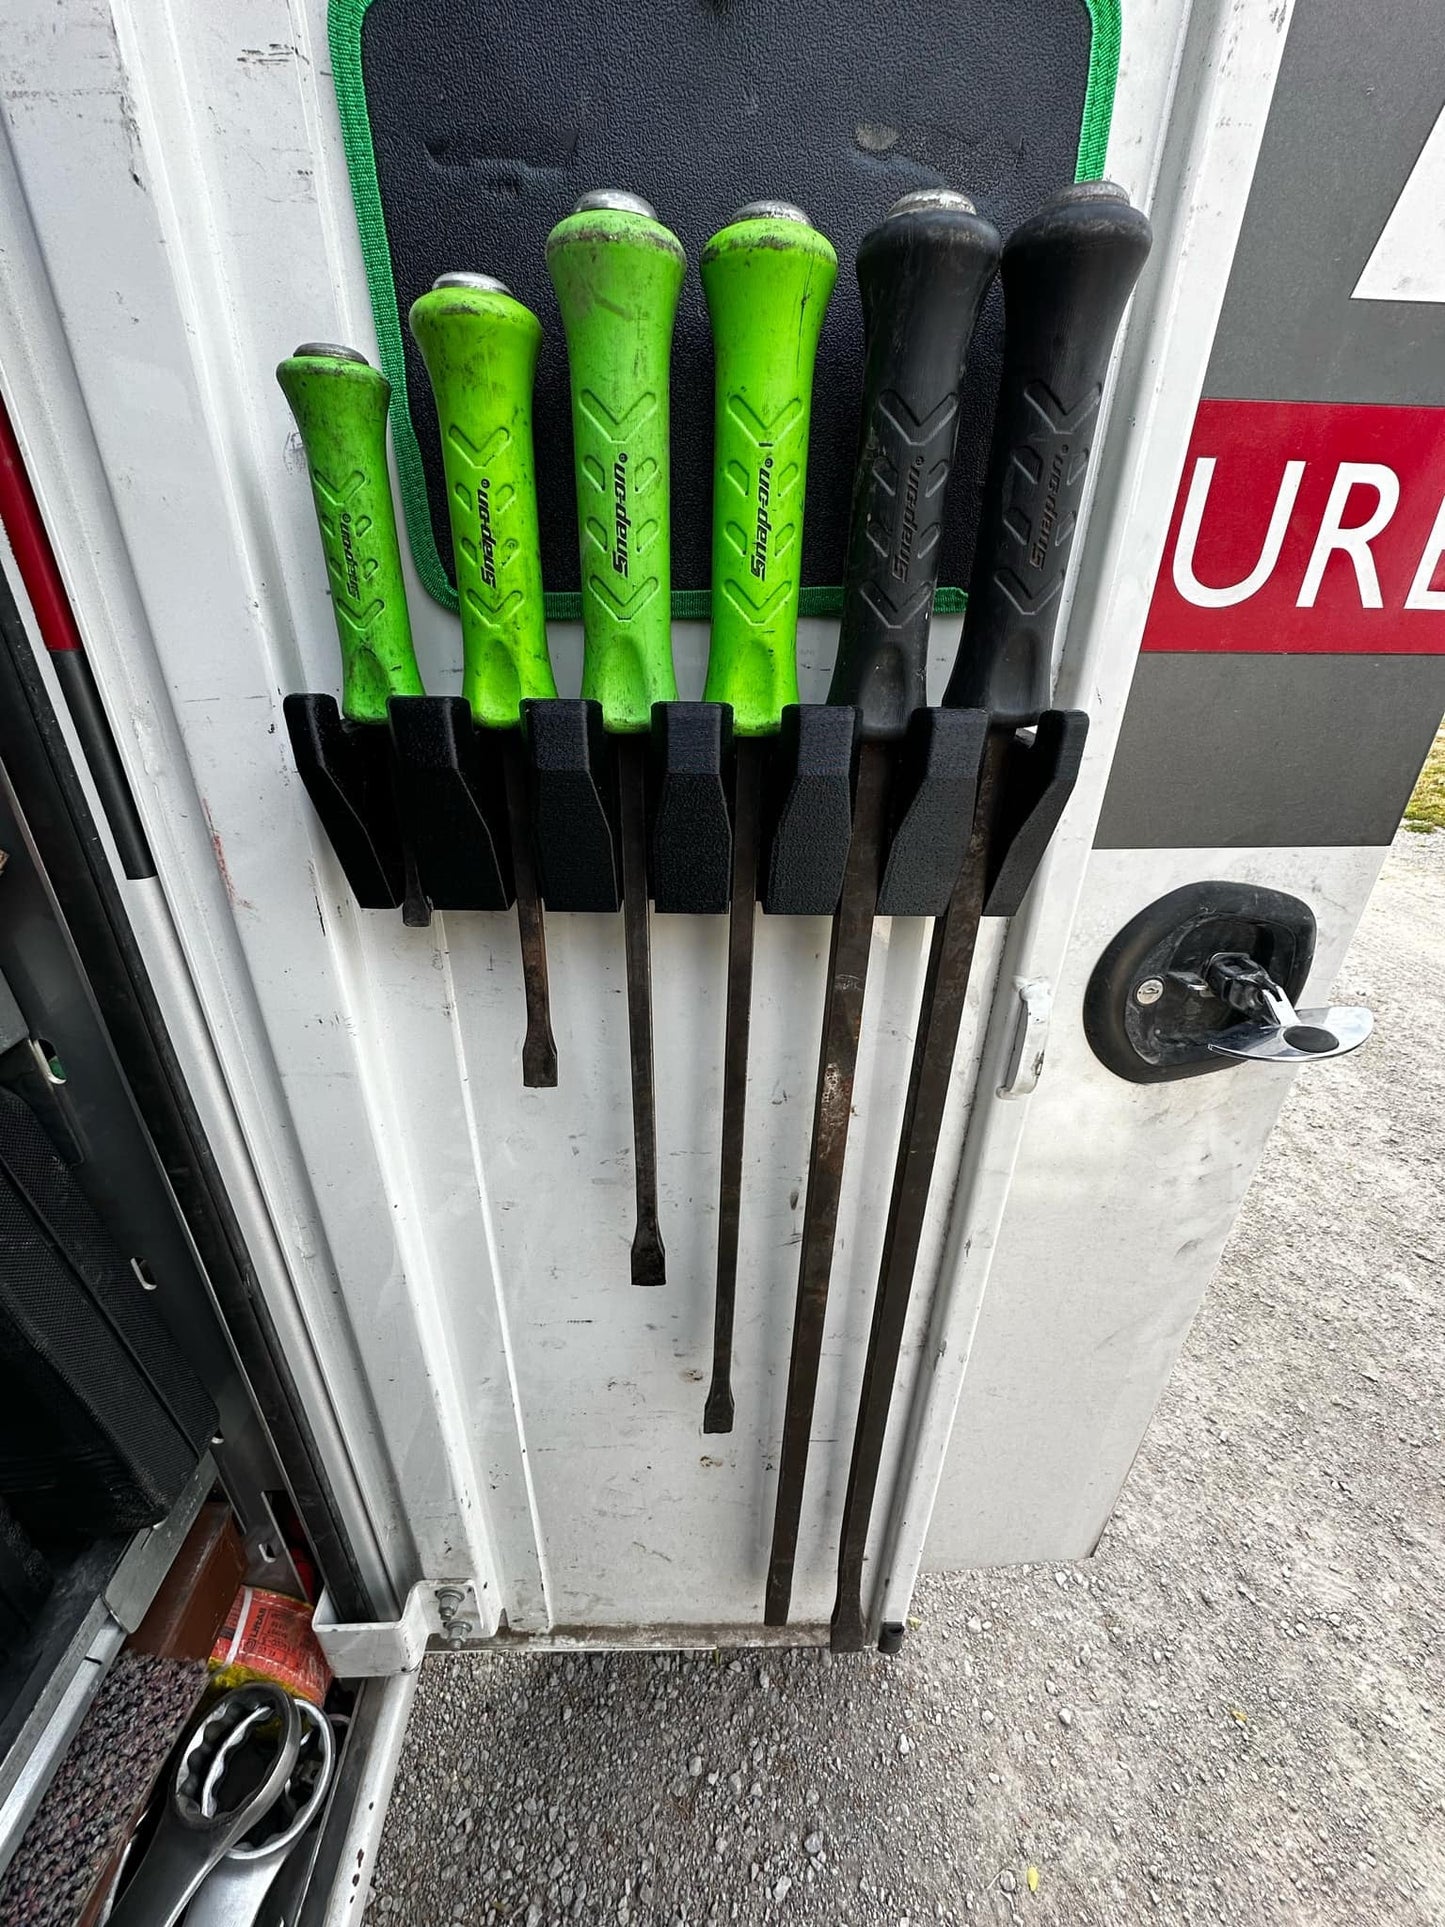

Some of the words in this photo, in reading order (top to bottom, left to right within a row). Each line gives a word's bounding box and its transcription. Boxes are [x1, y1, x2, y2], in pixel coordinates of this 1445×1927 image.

[339, 522, 361, 601] Snap-on
[477, 489, 497, 589] Snap-on
[611, 463, 632, 578] Snap-on
[750, 468, 772, 581] Snap-on
[891, 464, 923, 583] Snap-on
